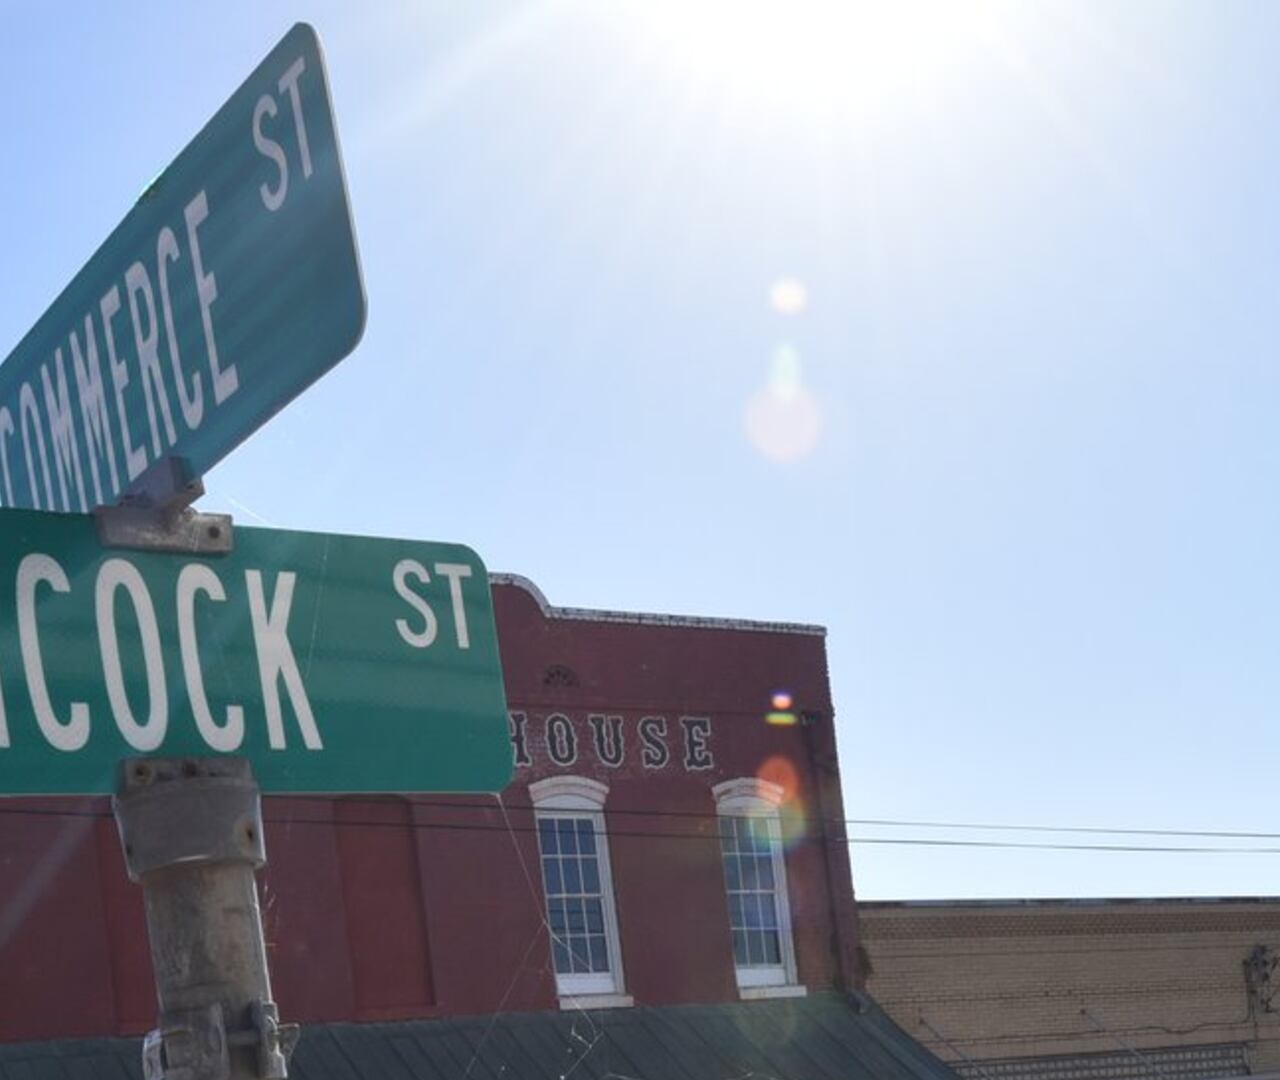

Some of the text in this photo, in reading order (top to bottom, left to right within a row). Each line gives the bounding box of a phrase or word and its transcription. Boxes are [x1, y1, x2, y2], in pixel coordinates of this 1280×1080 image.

[253, 57, 313, 212] ST
[392, 559, 472, 650] ST
[509, 710, 714, 770] HOUSE
